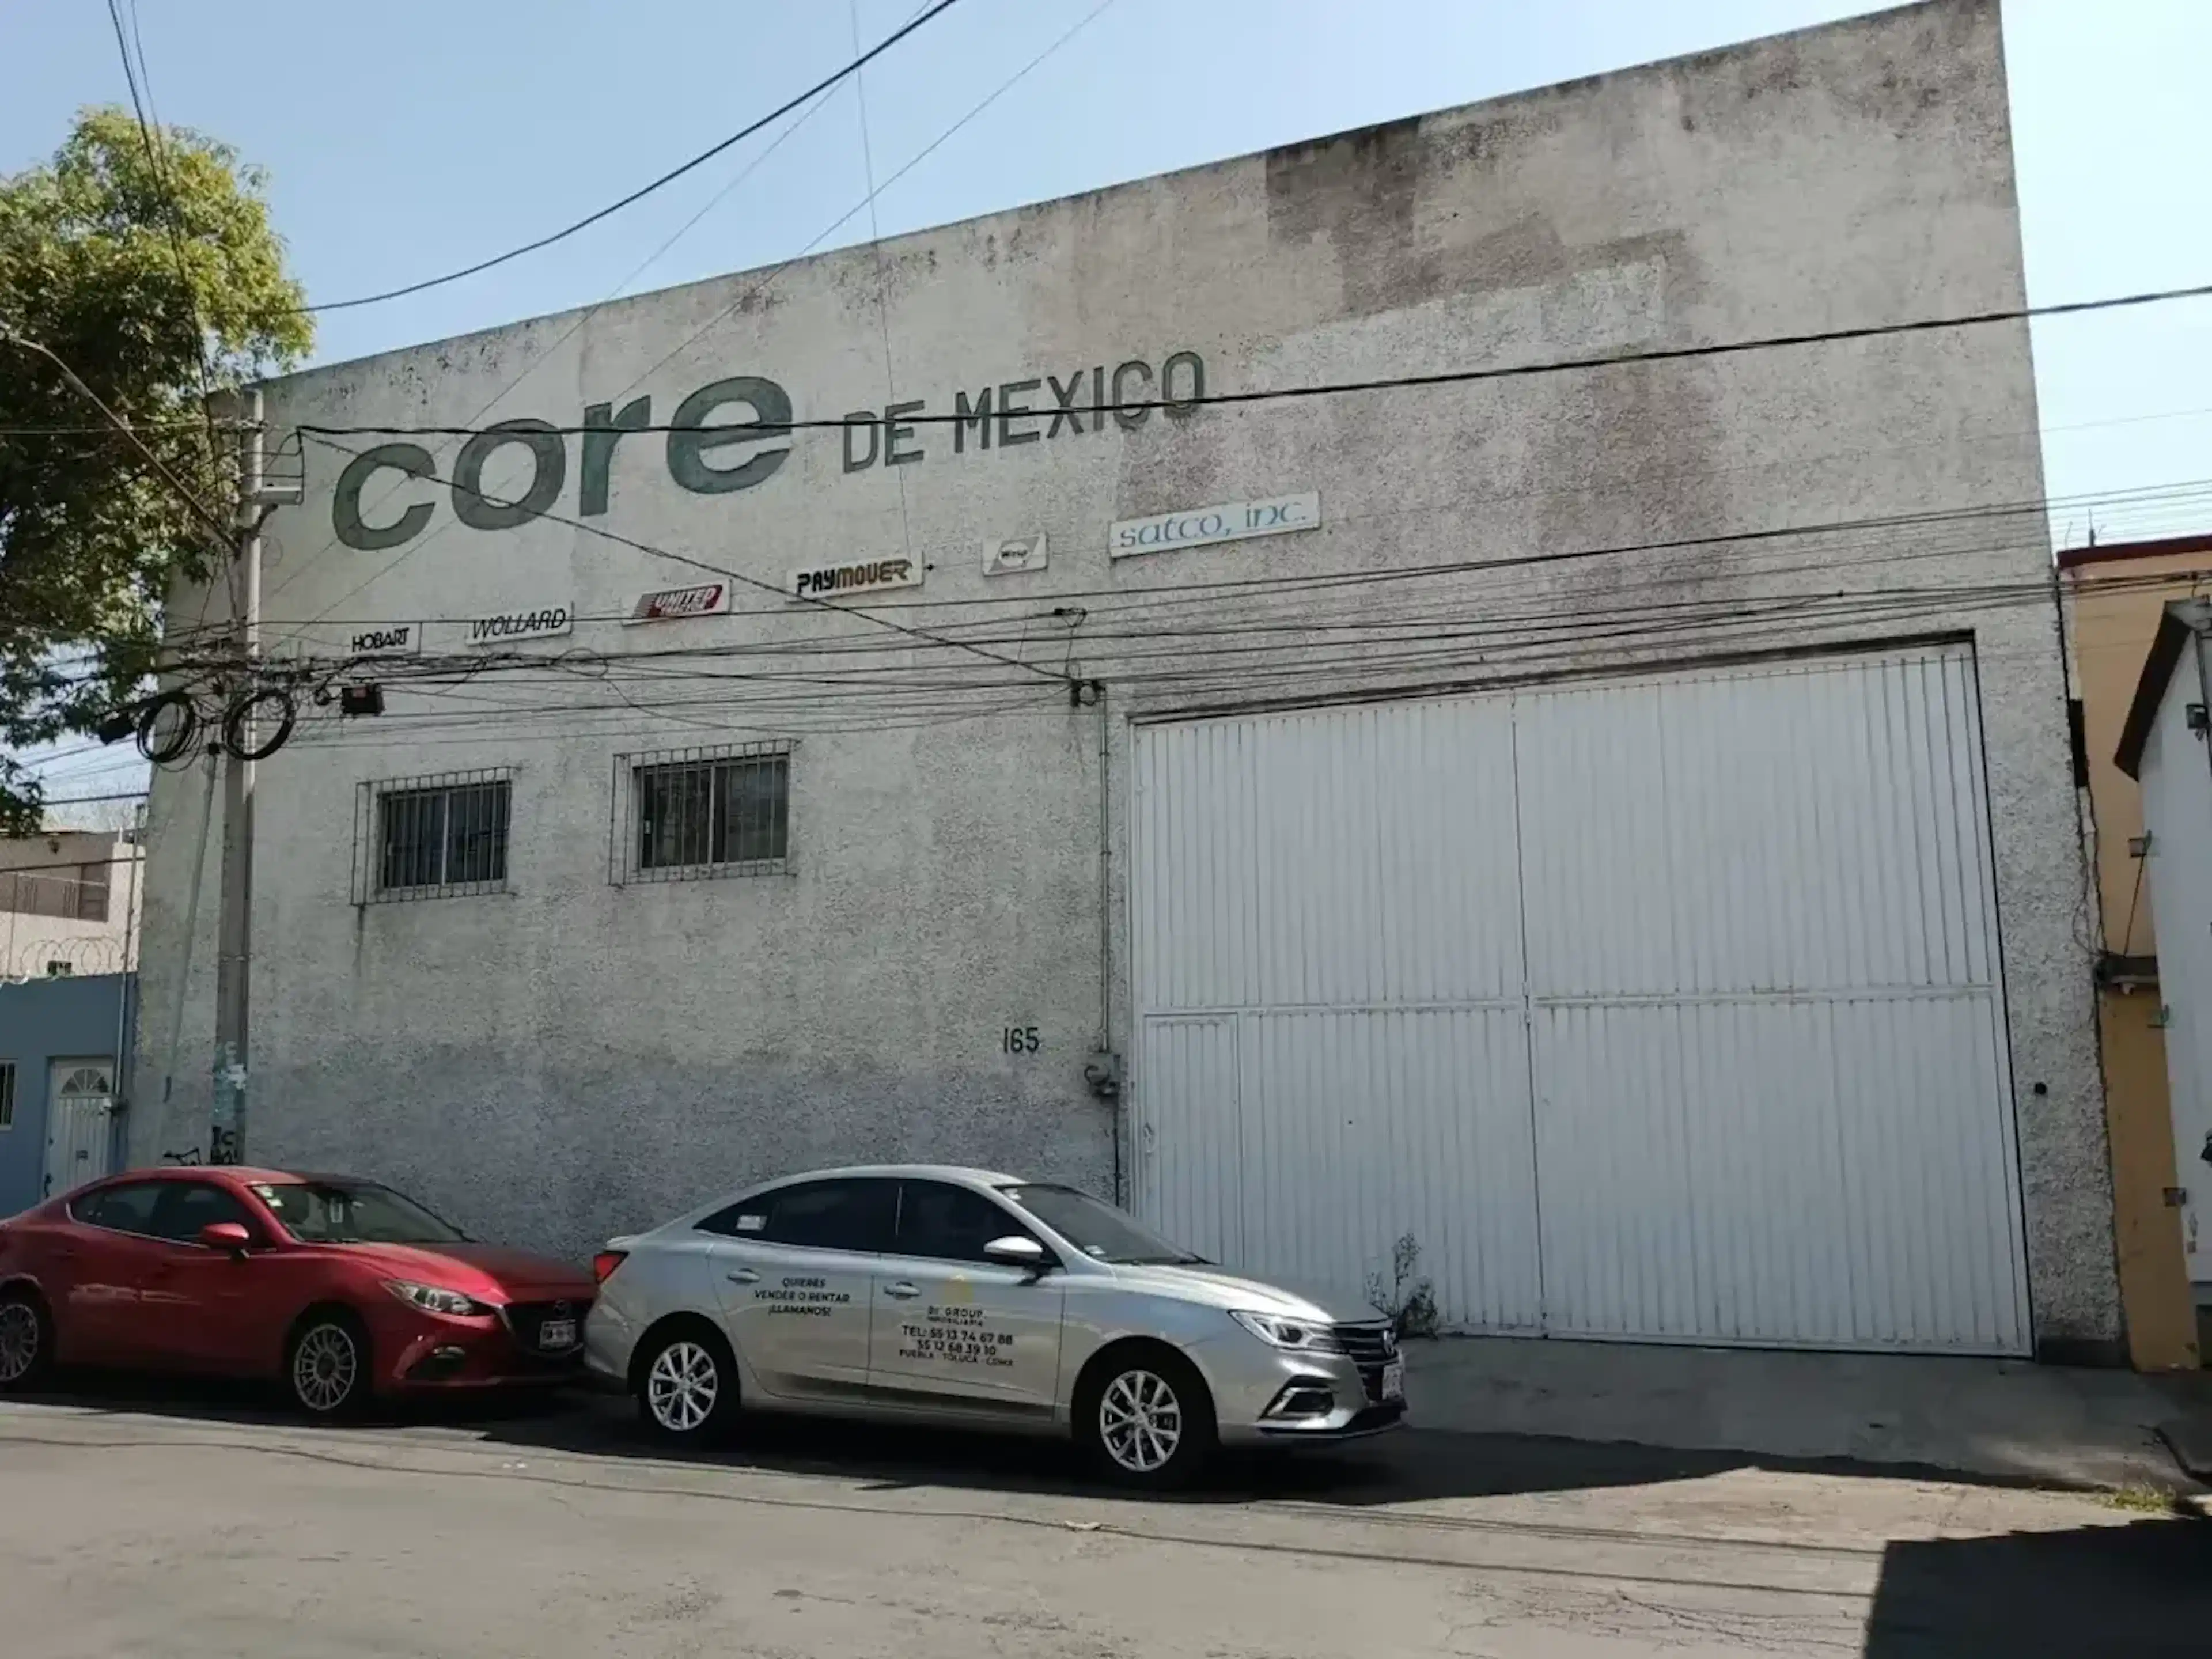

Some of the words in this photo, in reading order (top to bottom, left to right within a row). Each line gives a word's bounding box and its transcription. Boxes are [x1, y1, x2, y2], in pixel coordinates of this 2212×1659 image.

[332, 376, 792, 551] core
[842, 400, 925, 474] DE
[955, 350, 1205, 453] MEXICO
[1120, 513, 1231, 547] satco,
[1245, 502, 1306, 528] inc.
[797, 558, 912, 595] PAYMOVER
[472, 608, 566, 639] WOLLARD
[352, 627, 410, 652] HOBART
[1004, 1027, 1039, 1054] 165
[808, 1293, 850, 1303] RENTAR
[902, 1325, 927, 1338] TEL:
